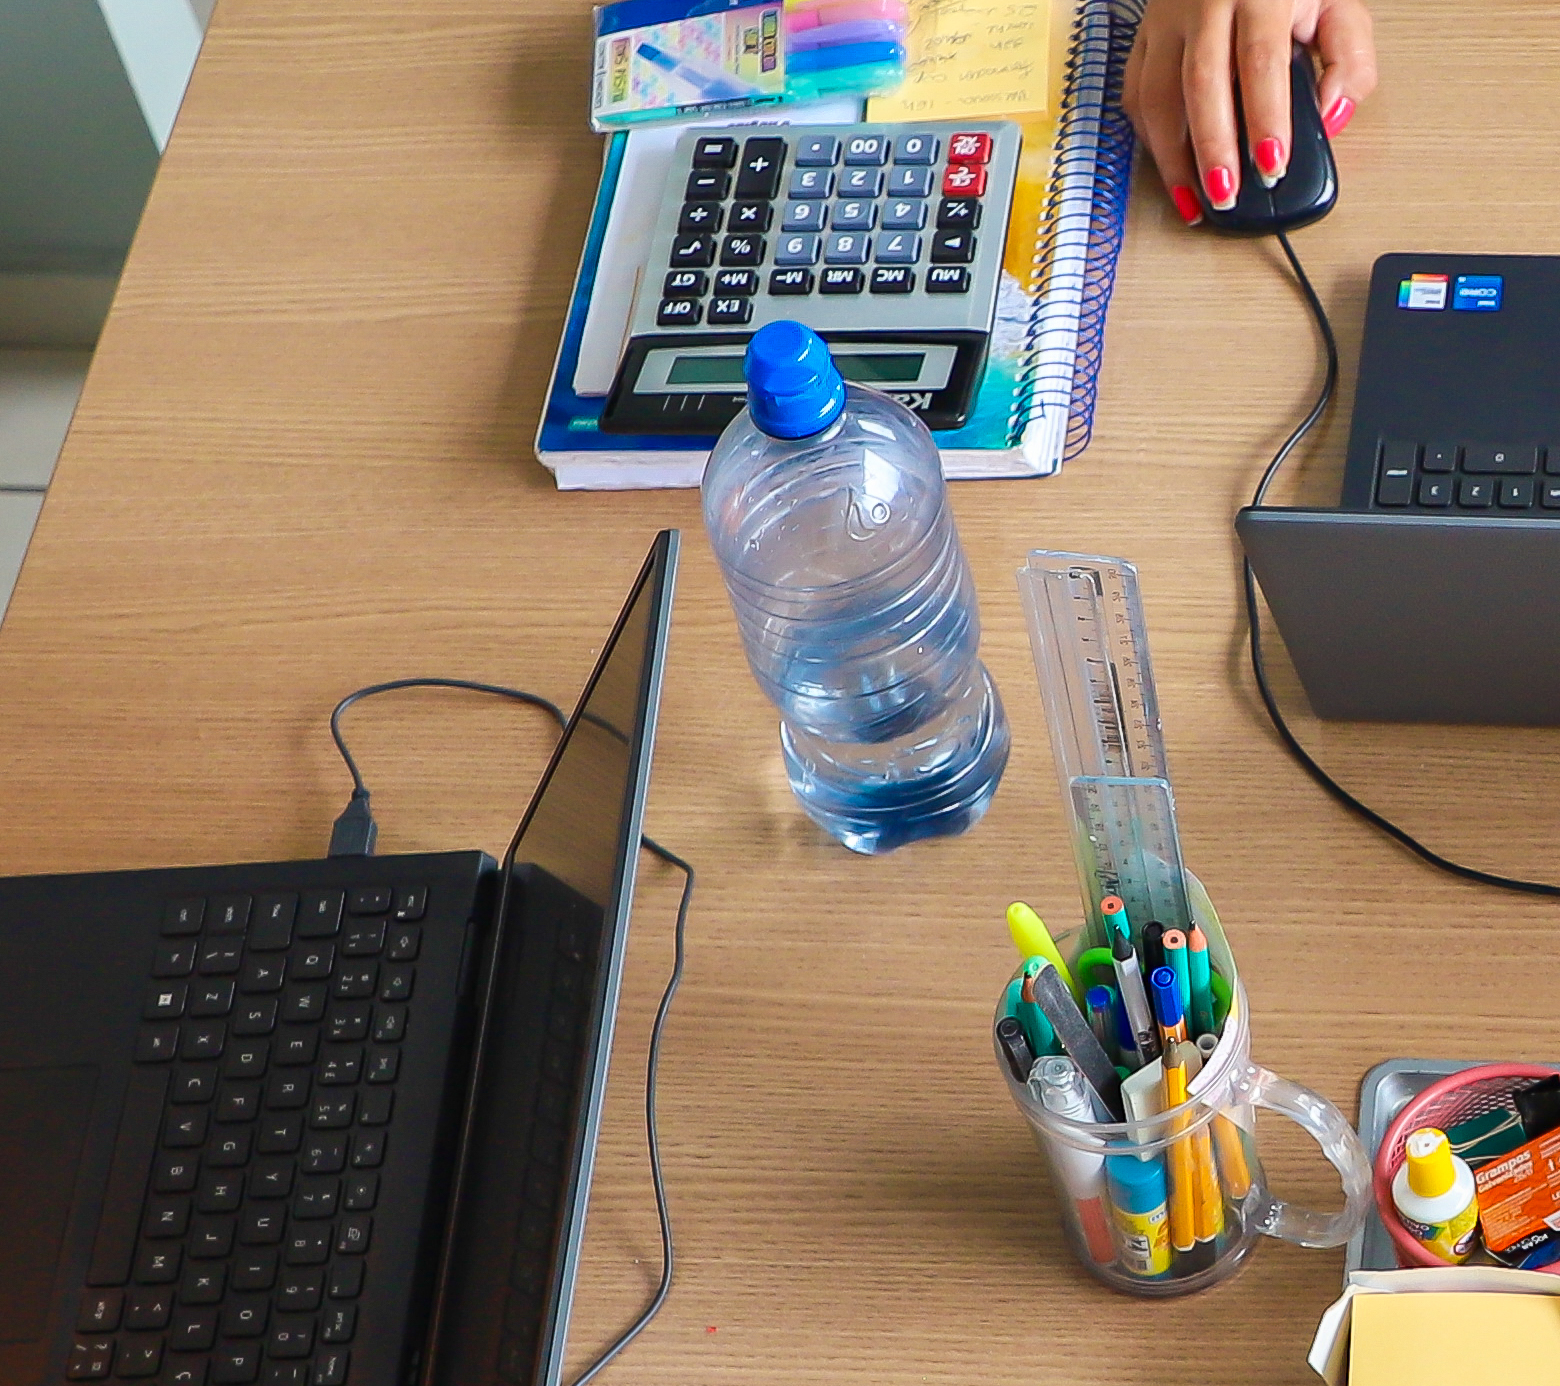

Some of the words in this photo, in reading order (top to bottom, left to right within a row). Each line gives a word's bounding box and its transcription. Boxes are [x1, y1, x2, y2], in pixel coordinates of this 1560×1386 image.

[850, 139, 878, 153] 00
[905, 139, 922, 153] 0
[801, 171, 817, 184] 3
[851, 171, 867, 184] 2
[902, 170, 914, 183] 1
[794, 204, 810, 218] 6
[843, 203, 860, 216] 5
[894, 203, 911, 216] 4
[787, 237, 803, 251] 9
[837, 236, 853, 251] 8
[887, 235, 902, 250] 7
[671, 273, 696, 286] GT
[826, 270, 853, 282] MR
[876, 269, 904, 281] MC
[932, 269, 960, 280] MU
[663, 301, 691, 313] OFF
[716, 300, 739, 312] EX
[1476, 1147, 1533, 1187] Grampos
